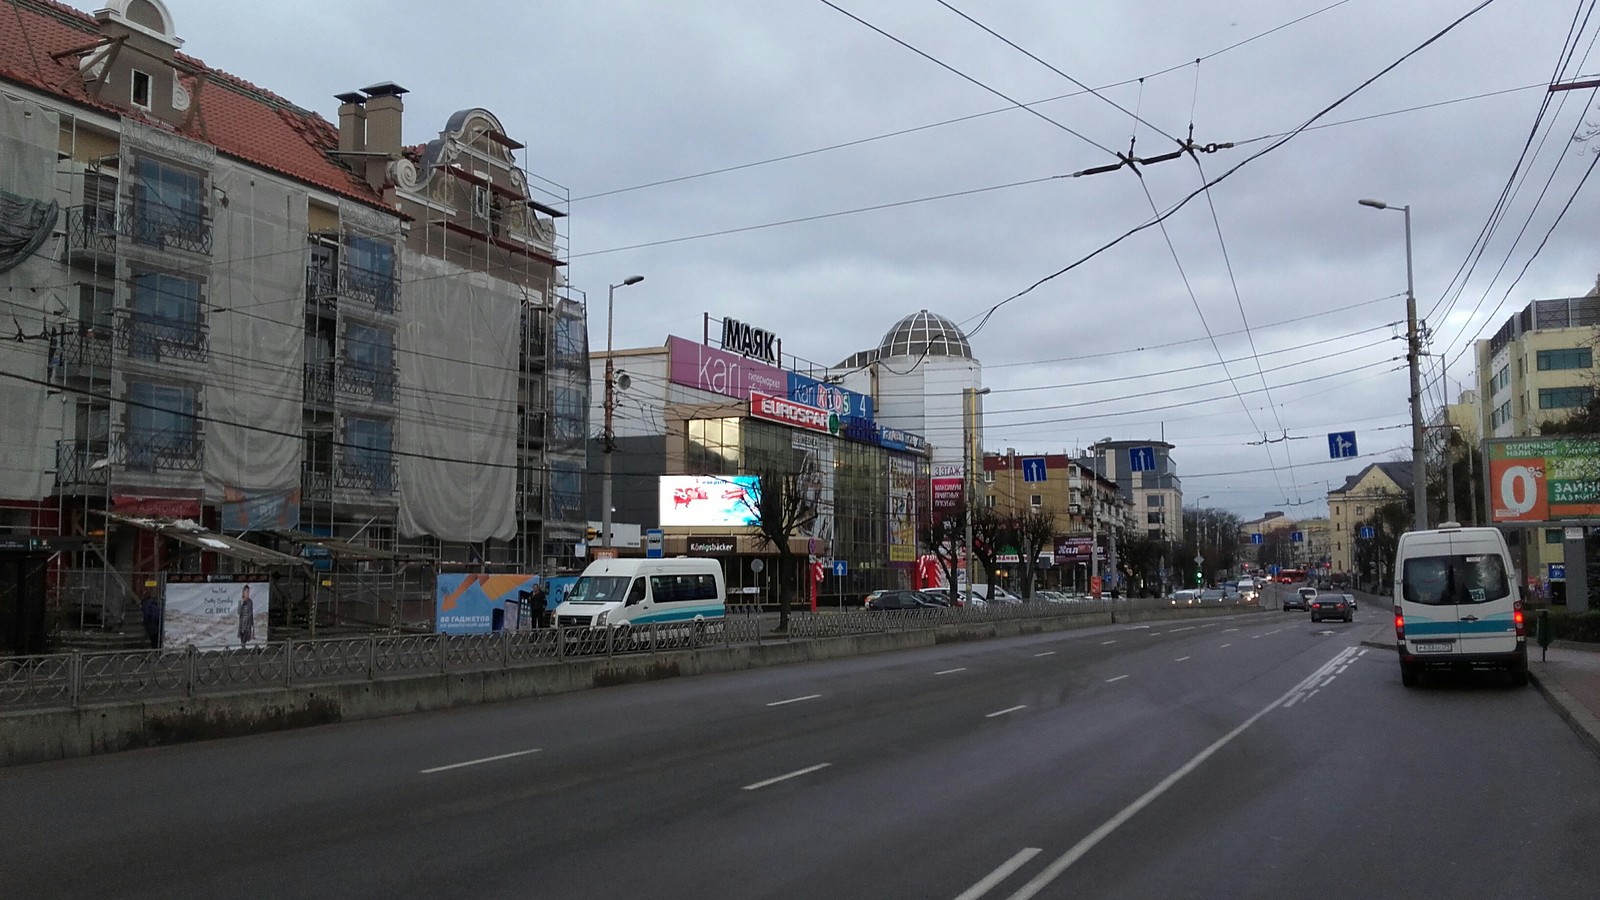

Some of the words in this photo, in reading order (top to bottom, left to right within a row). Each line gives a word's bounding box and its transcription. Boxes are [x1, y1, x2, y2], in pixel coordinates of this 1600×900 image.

[722, 316, 776, 363] МАЯК
[698, 343, 741, 399] kari
[761, 398, 829, 427] EUROSPAR
[690, 543, 733, 552] Königsbäcker
[451, 615, 490, 623] ГАДЖЕТОВ
